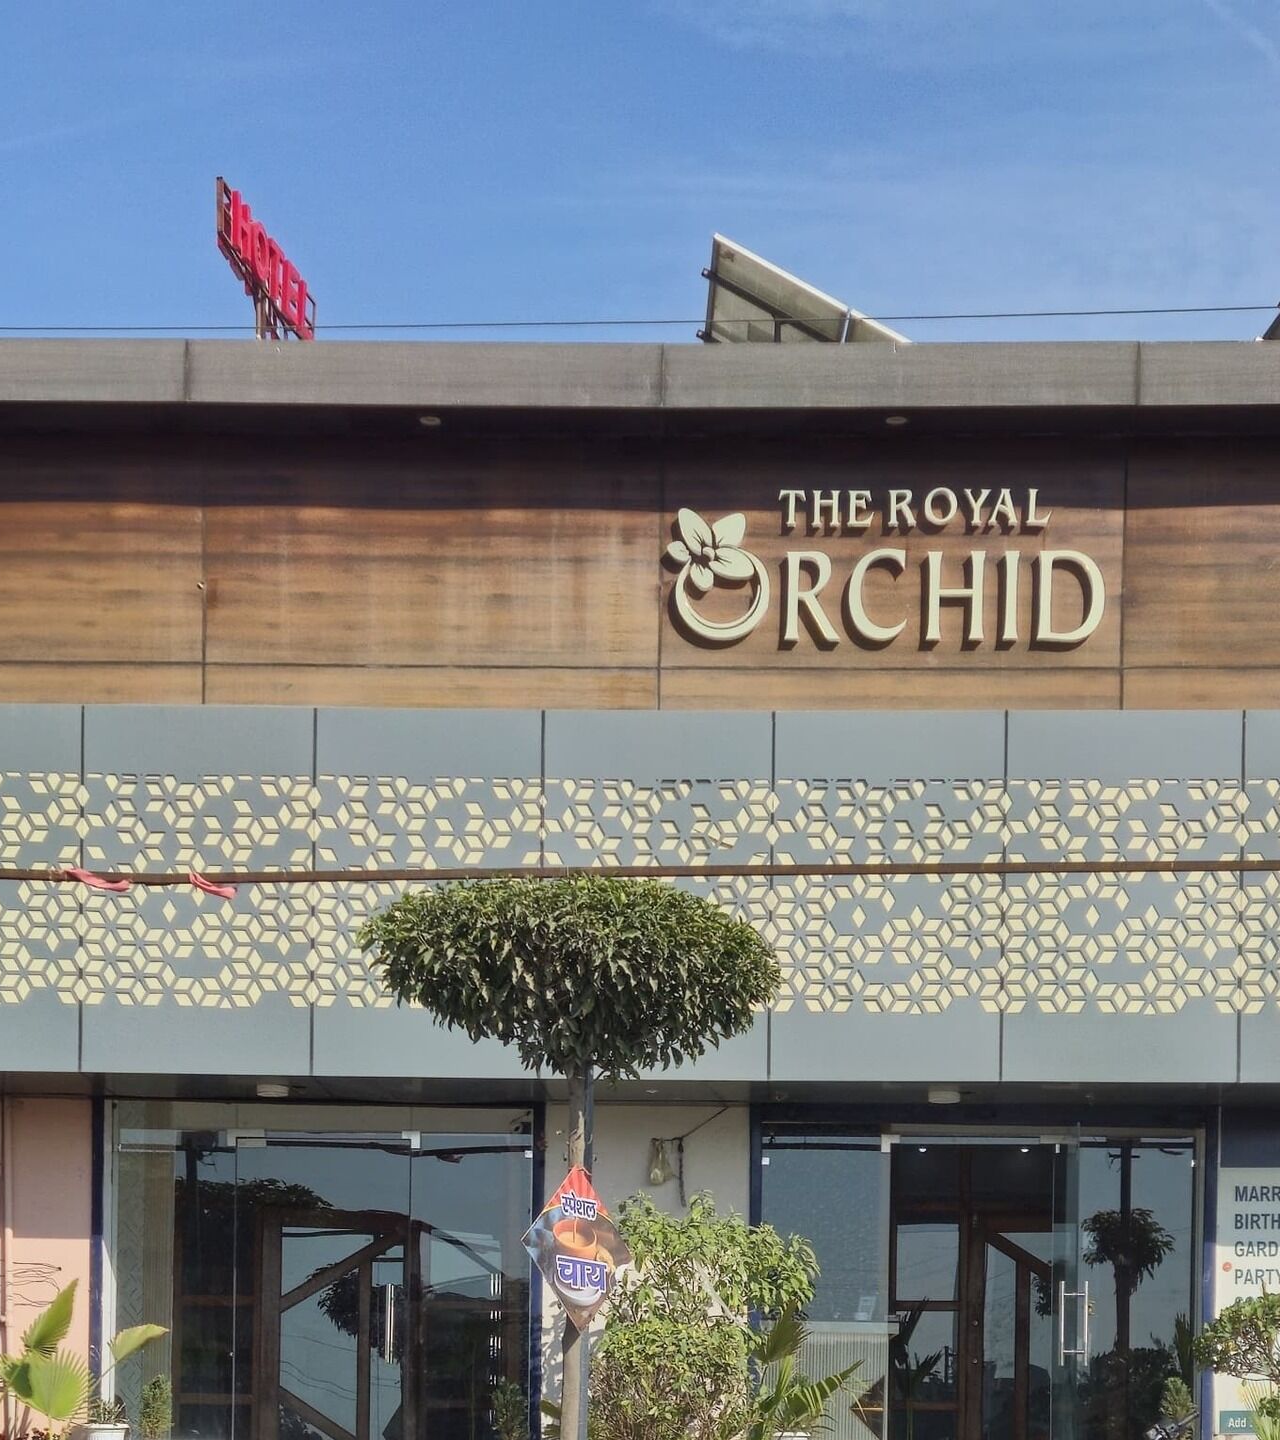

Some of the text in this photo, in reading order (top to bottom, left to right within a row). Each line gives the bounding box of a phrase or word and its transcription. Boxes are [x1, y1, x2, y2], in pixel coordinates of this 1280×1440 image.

[778, 486, 1053, 528] THE ROYAL
[666, 508, 1106, 643] ORCHID
[561, 1193, 597, 1220] स्पेशल
[556, 1256, 607, 1291] चाय
